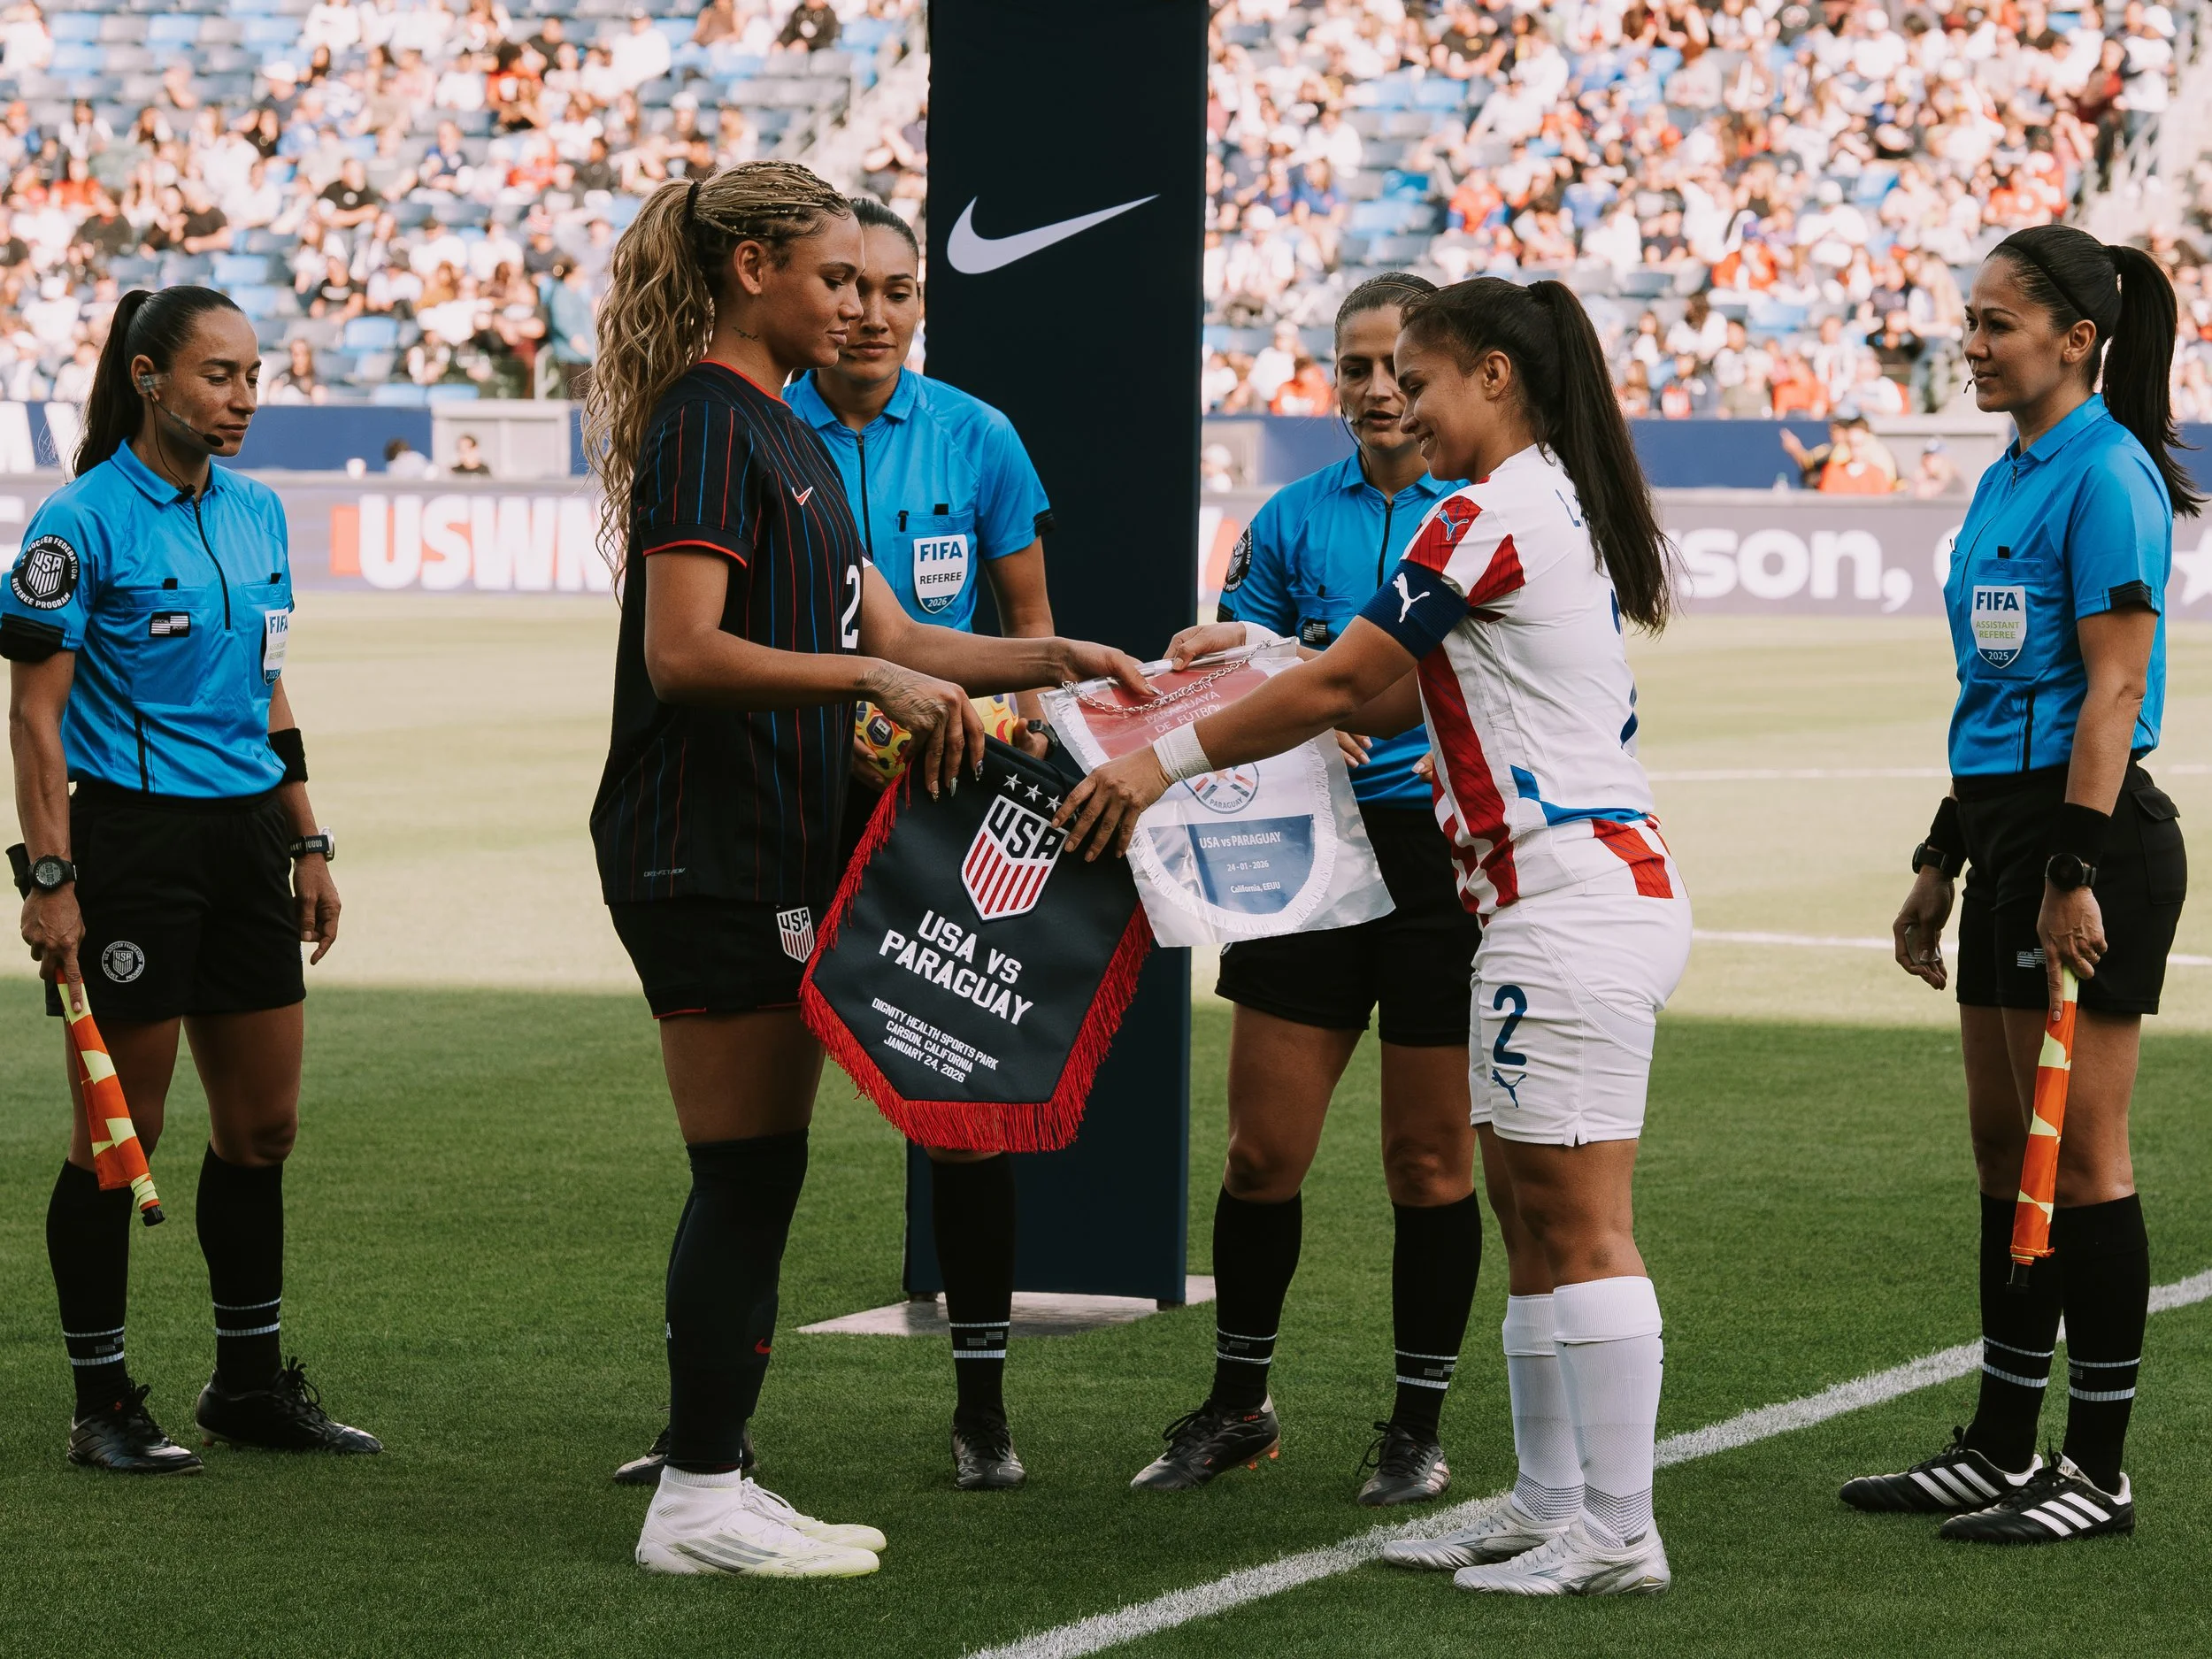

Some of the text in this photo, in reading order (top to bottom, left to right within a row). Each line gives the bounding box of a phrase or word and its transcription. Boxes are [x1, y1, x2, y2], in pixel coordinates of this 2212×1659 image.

[53, 537, 78, 580] FEDERATION
[920, 541, 963, 562] FIFA
[35, 552, 62, 572] USA
[920, 572, 962, 585] REFEREE
[12, 577, 71, 609] REFEREE PROGRAM
[927, 597, 947, 608] 2026
[1976, 591, 2020, 611] FIFA
[841, 565, 860, 649] 2
[1976, 620, 2020, 629] ASSISTANT
[1978, 630, 2016, 639] REFEREE
[1988, 651, 2008, 661] 2025
[1155, 721, 1174, 733] DE
[1210, 796, 1243, 809] PARAGUAY
[988, 800, 1066, 860] USA
[1199, 832, 1281, 849] USA vs PARAGUAY
[1230, 881, 1281, 893] California, EEUU
[780, 910, 809, 933] USA
[115, 951, 132, 962] USA
[918, 910, 1022, 984] USA VS
[879, 929, 1033, 1025] PARAGUAY
[872, 997, 999, 1071] DIGNITY HEALTH SPORTS PARK
[1493, 984, 1528, 1067] 2
[886, 1020, 974, 1073] CARSON, CALIFORNIA
[883, 1035, 966, 1083] JANUARY 24, 2026
